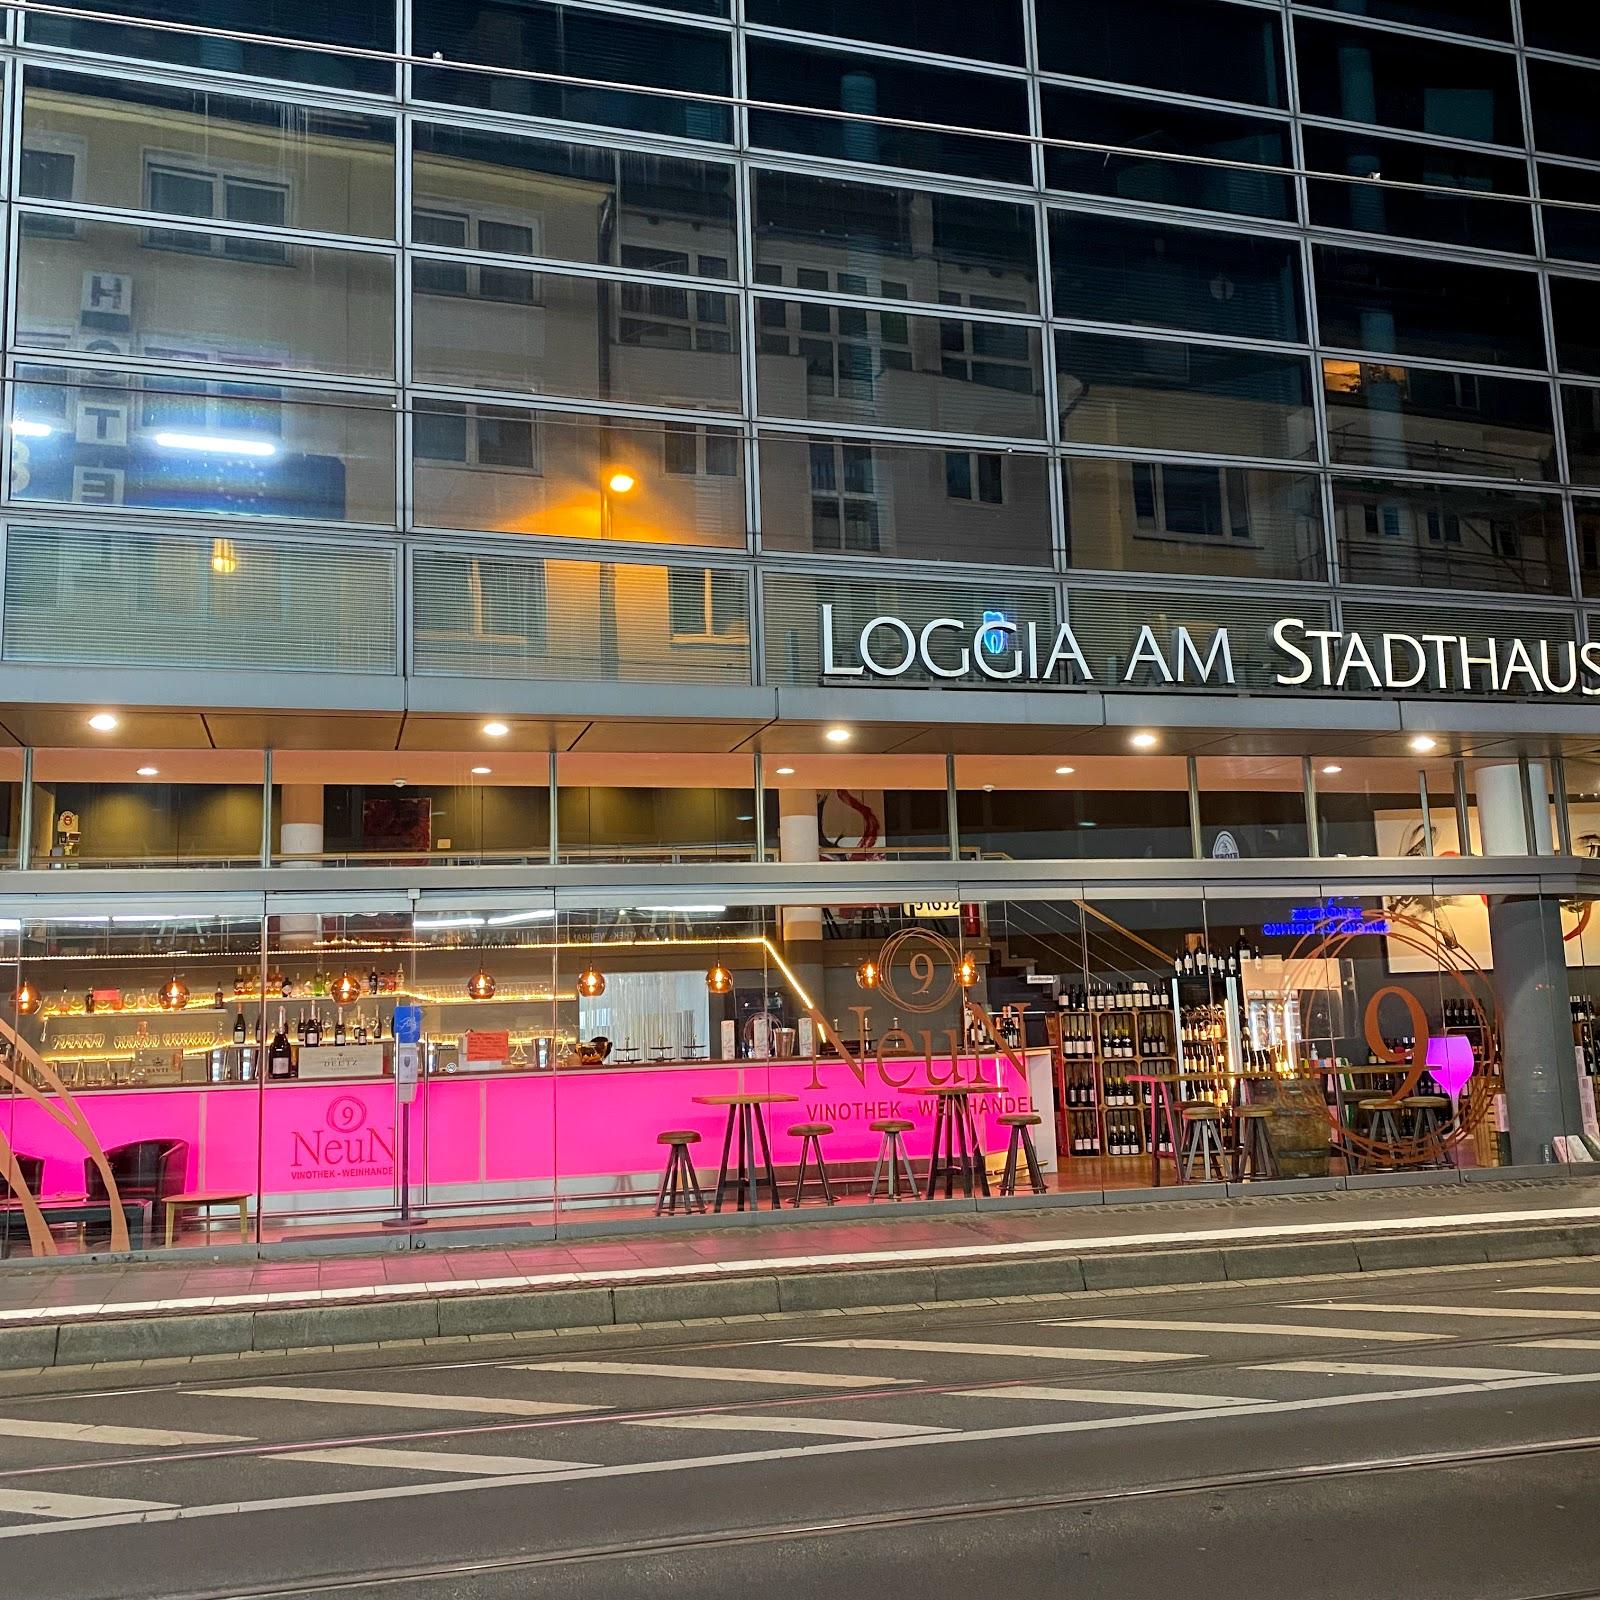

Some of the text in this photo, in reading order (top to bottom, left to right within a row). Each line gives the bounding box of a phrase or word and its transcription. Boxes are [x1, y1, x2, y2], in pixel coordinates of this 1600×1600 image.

[821, 603, 1600, 696] LOGGIA AM STADTHAUS
[908, 952, 935, 996] 9
[803, 1001, 1032, 1090] NeuN
[1363, 985, 1430, 1108] 9
[342, 1106, 354, 1126] 9
[806, 1101, 901, 1121] VINOTHEK
[918, 1096, 1040, 1117] WEINHANDEL
[290, 1126, 396, 1168] NeuN
[290, 1169, 336, 1180] VINOTHEK
[341, 1166, 394, 1177] WEINHANDE
